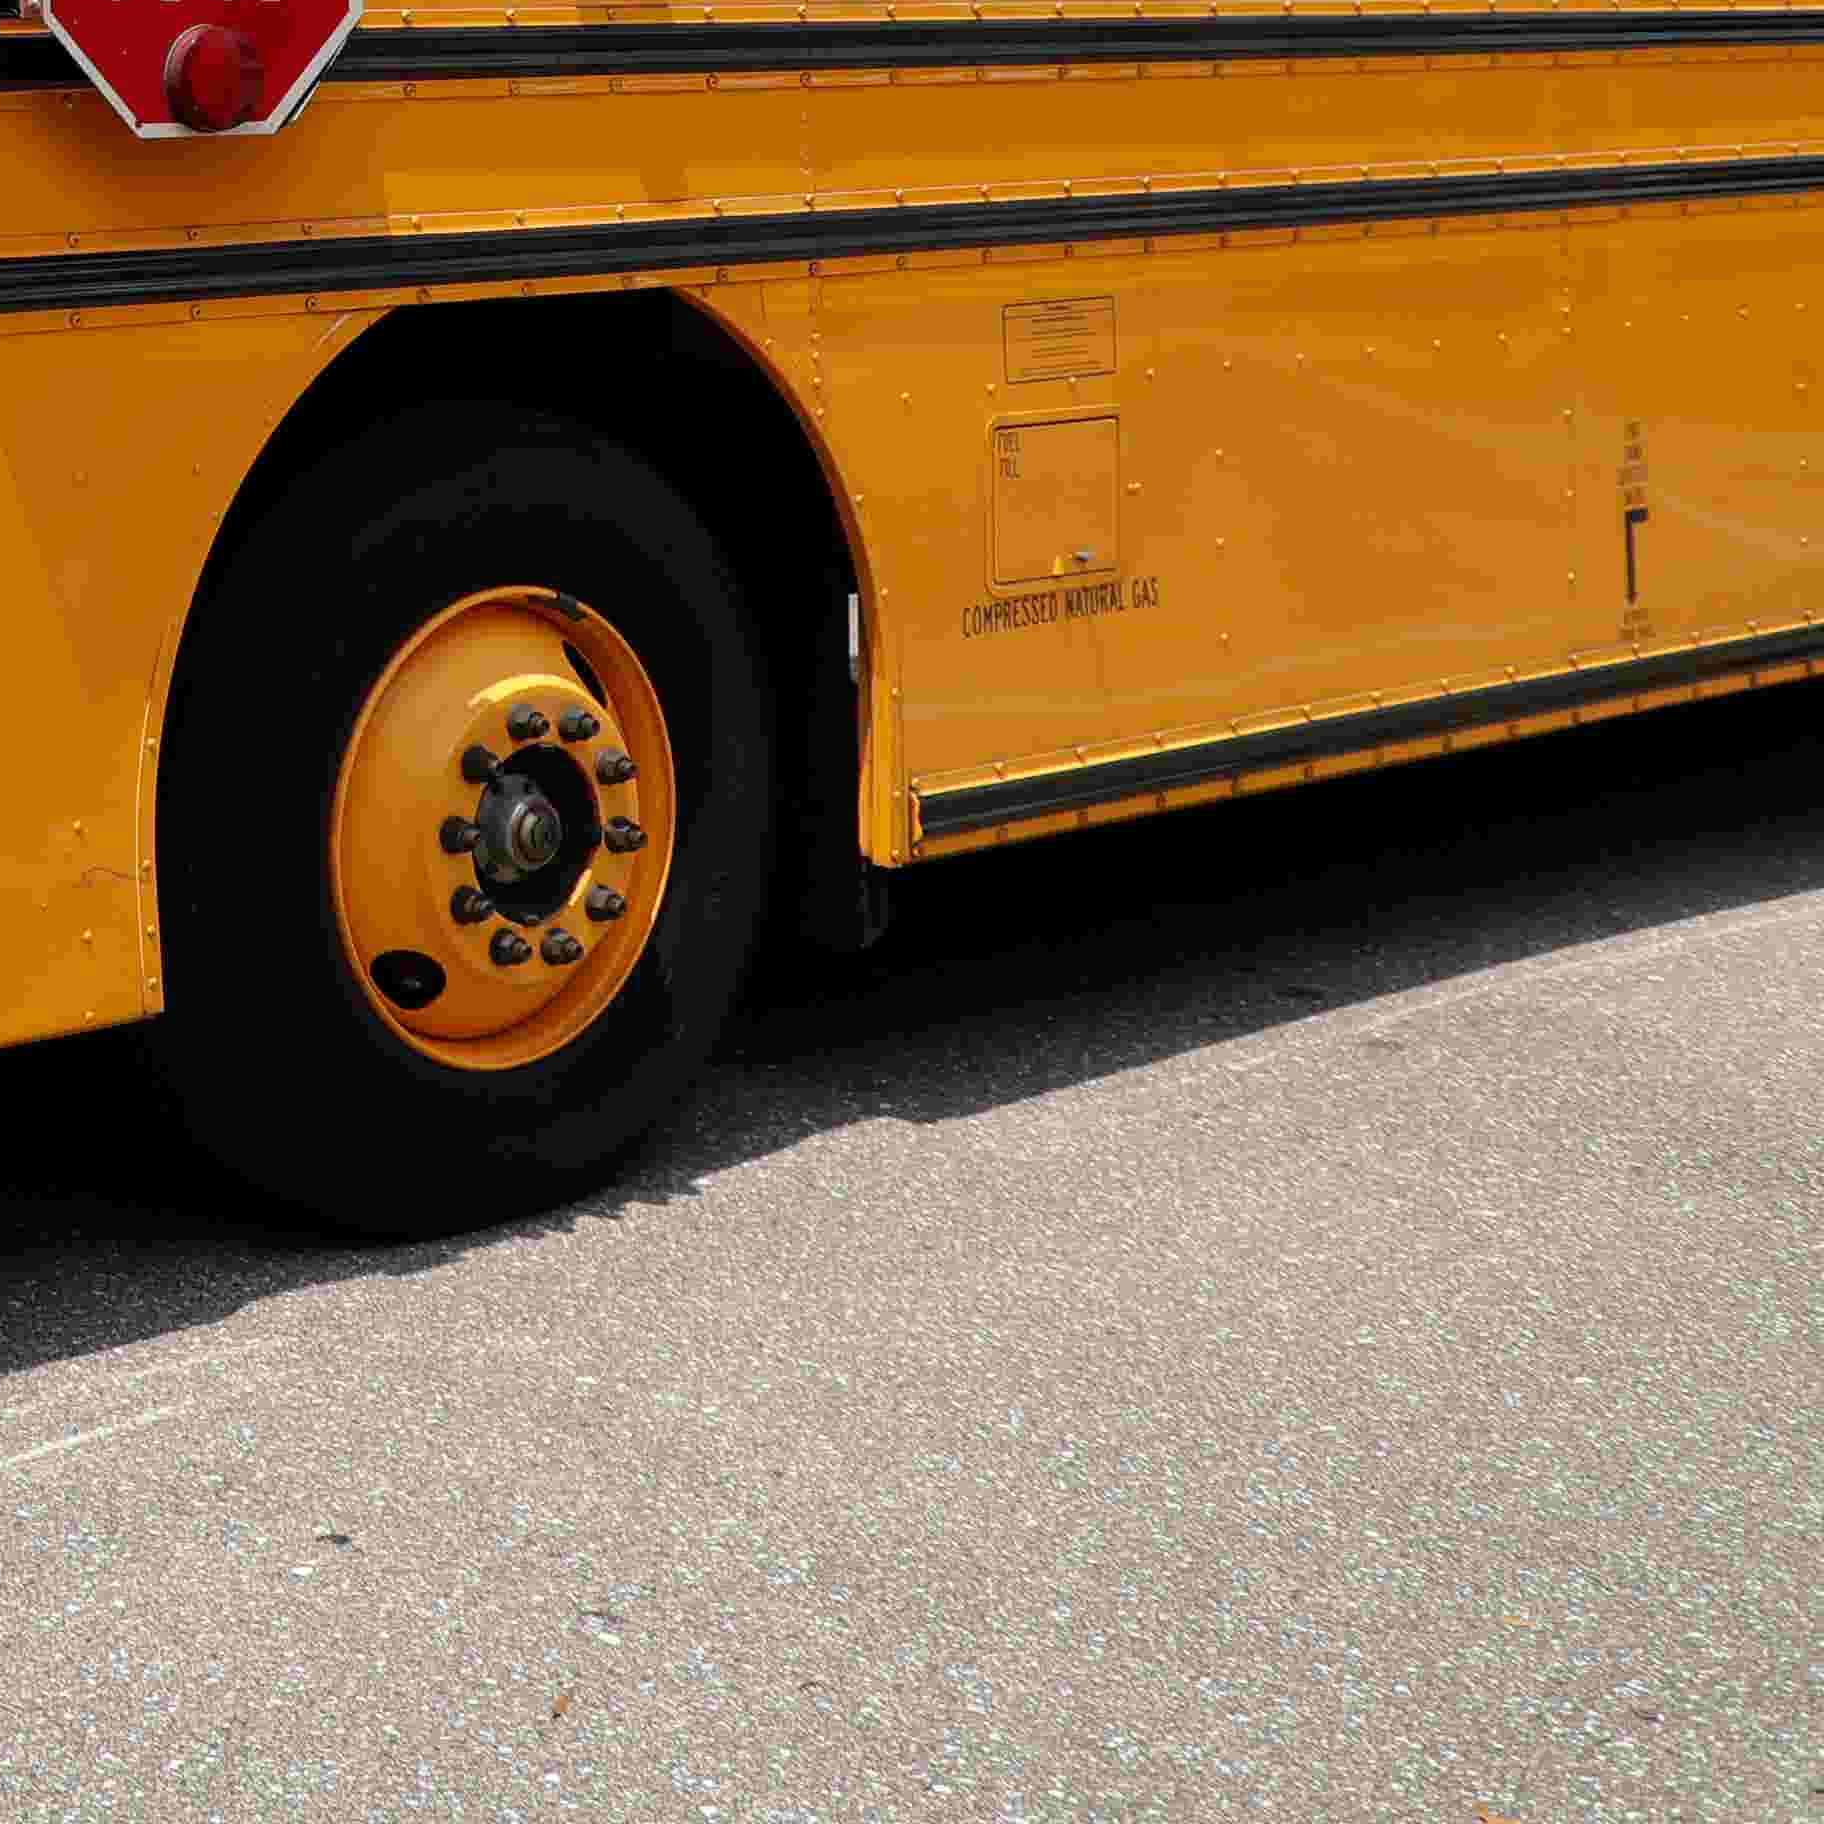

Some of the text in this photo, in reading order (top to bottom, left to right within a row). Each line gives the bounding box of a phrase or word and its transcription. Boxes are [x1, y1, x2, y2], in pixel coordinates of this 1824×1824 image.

[962, 576, 1160, 639] COMPRESSED NATURAL GAS
